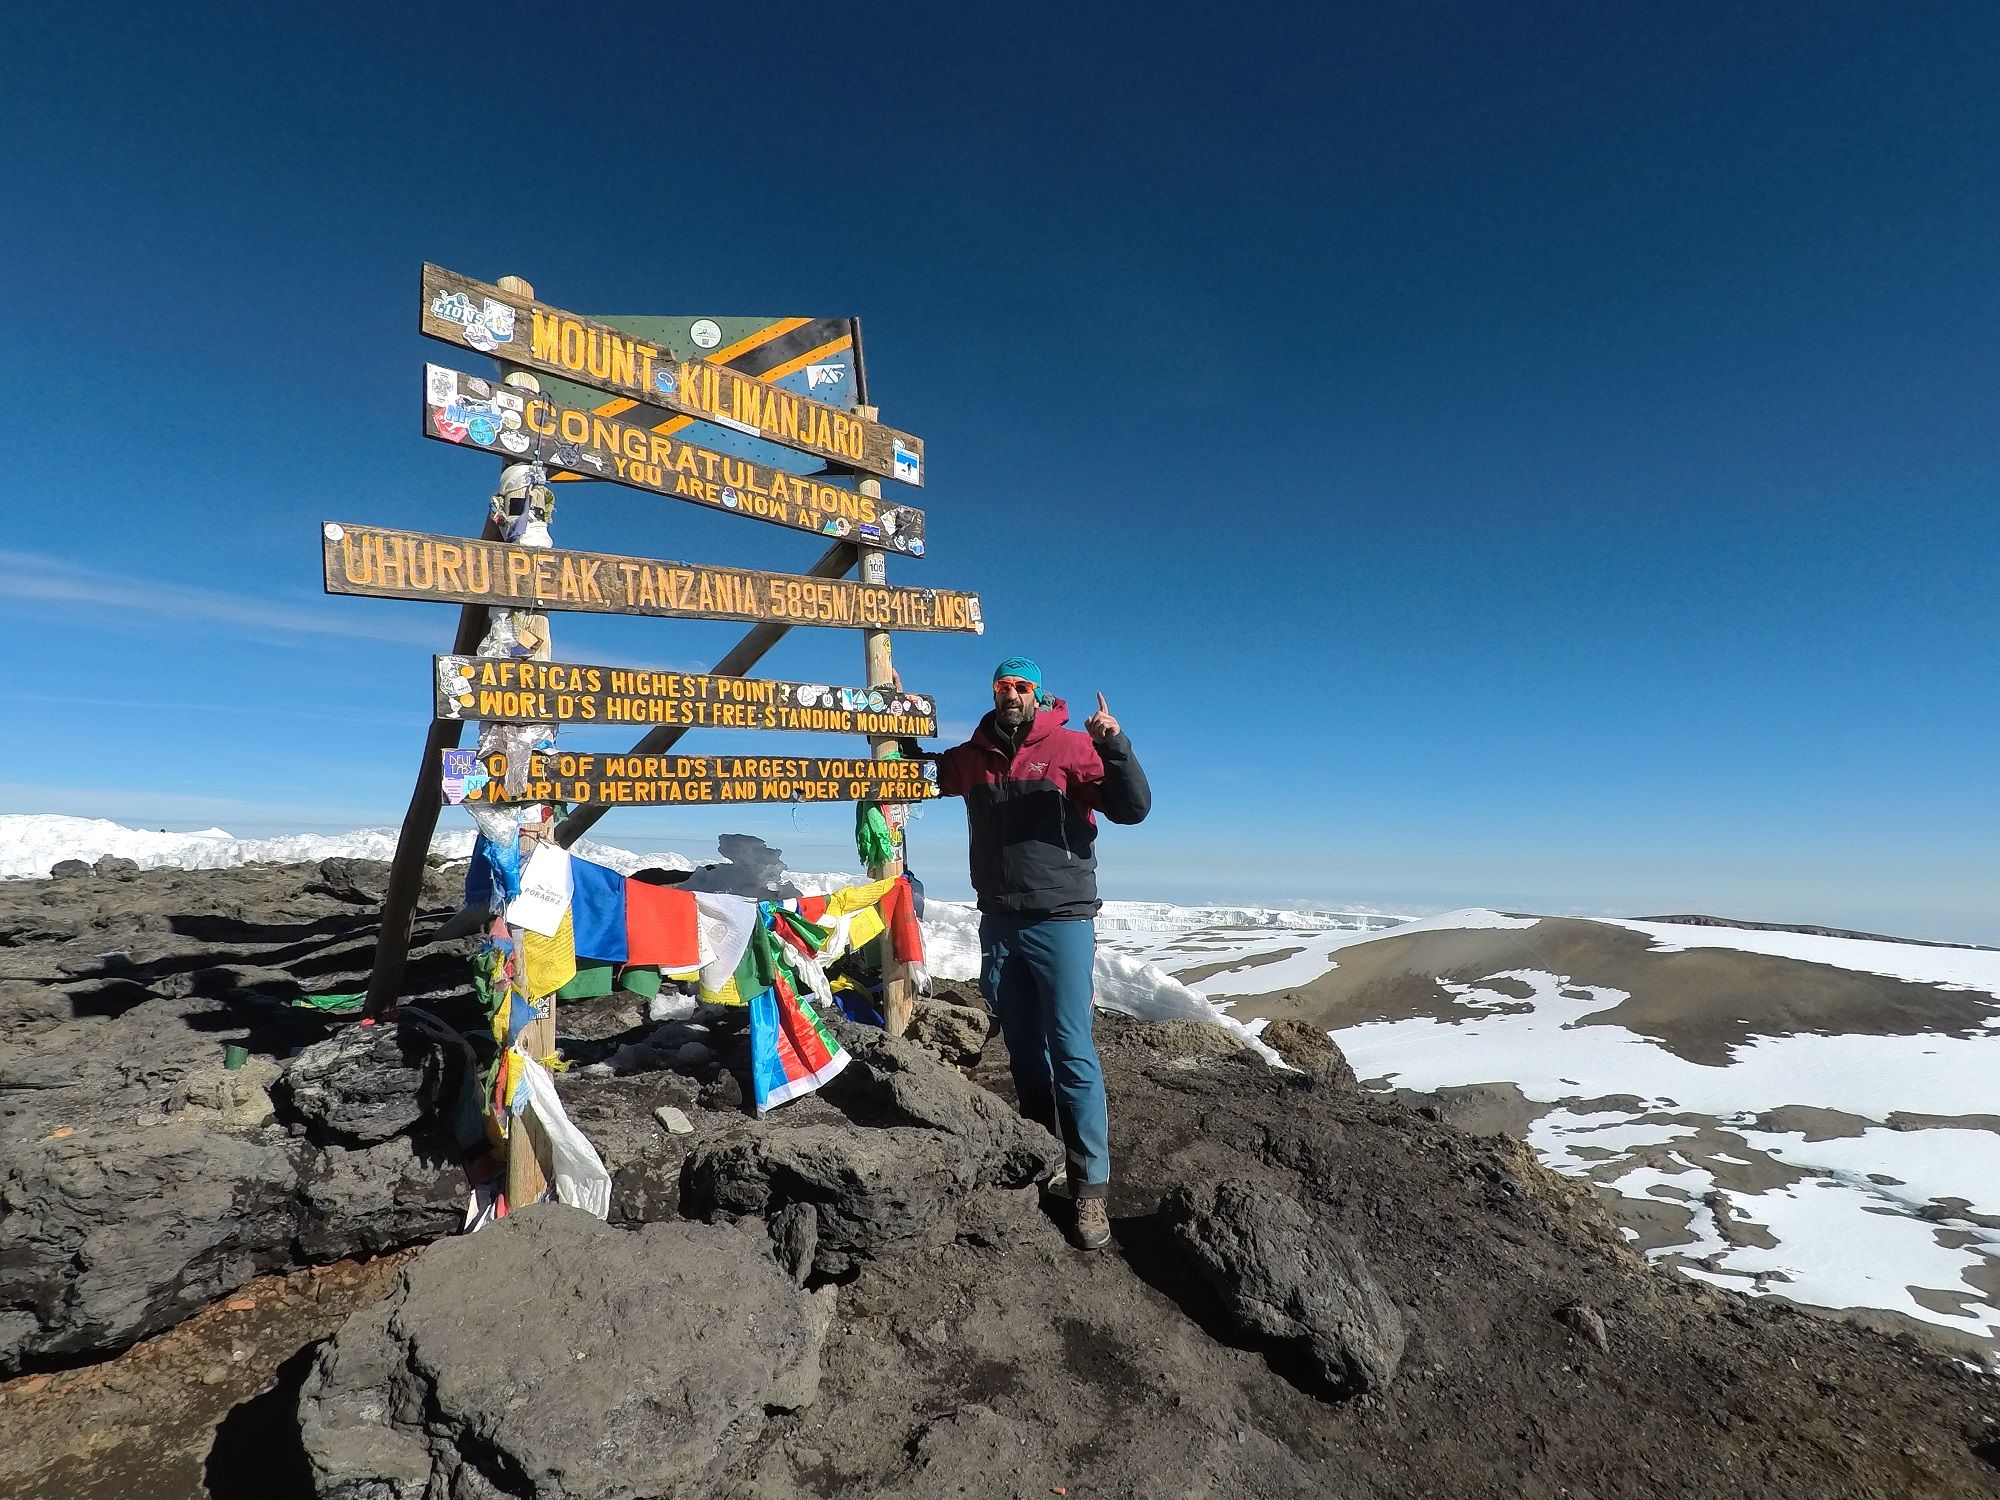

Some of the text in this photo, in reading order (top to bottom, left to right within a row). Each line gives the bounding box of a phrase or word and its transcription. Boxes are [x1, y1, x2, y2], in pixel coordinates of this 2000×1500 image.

[531, 309, 863, 460] MOUNT KILIMANJARO
[525, 400, 876, 523] CONGRATULATIONS
[614, 456, 821, 530] YOU ARE NOW AT
[343, 531, 491, 594] UHURU
[508, 550, 611, 607] PEAK,
[618, 563, 765, 618] TANZANIA,
[934, 595, 976, 629] AMSL
[479, 690, 596, 719] WORLD'S
[606, 696, 707, 724] HIGHEST
[857, 713, 930, 736] MOUNTAIN
[610, 669, 709, 698] HIGHEST
[718, 678, 776, 704] POINT
[488, 754, 920, 780] OE OF WORLD'S LARGEST VOLCANOES
[600, 781, 713, 802] HERITAGE
[720, 782, 757, 800] AND
[762, 781, 840, 800] WONDER
[849, 781, 871, 799] OF
[879, 782, 931, 799] AFRICA
